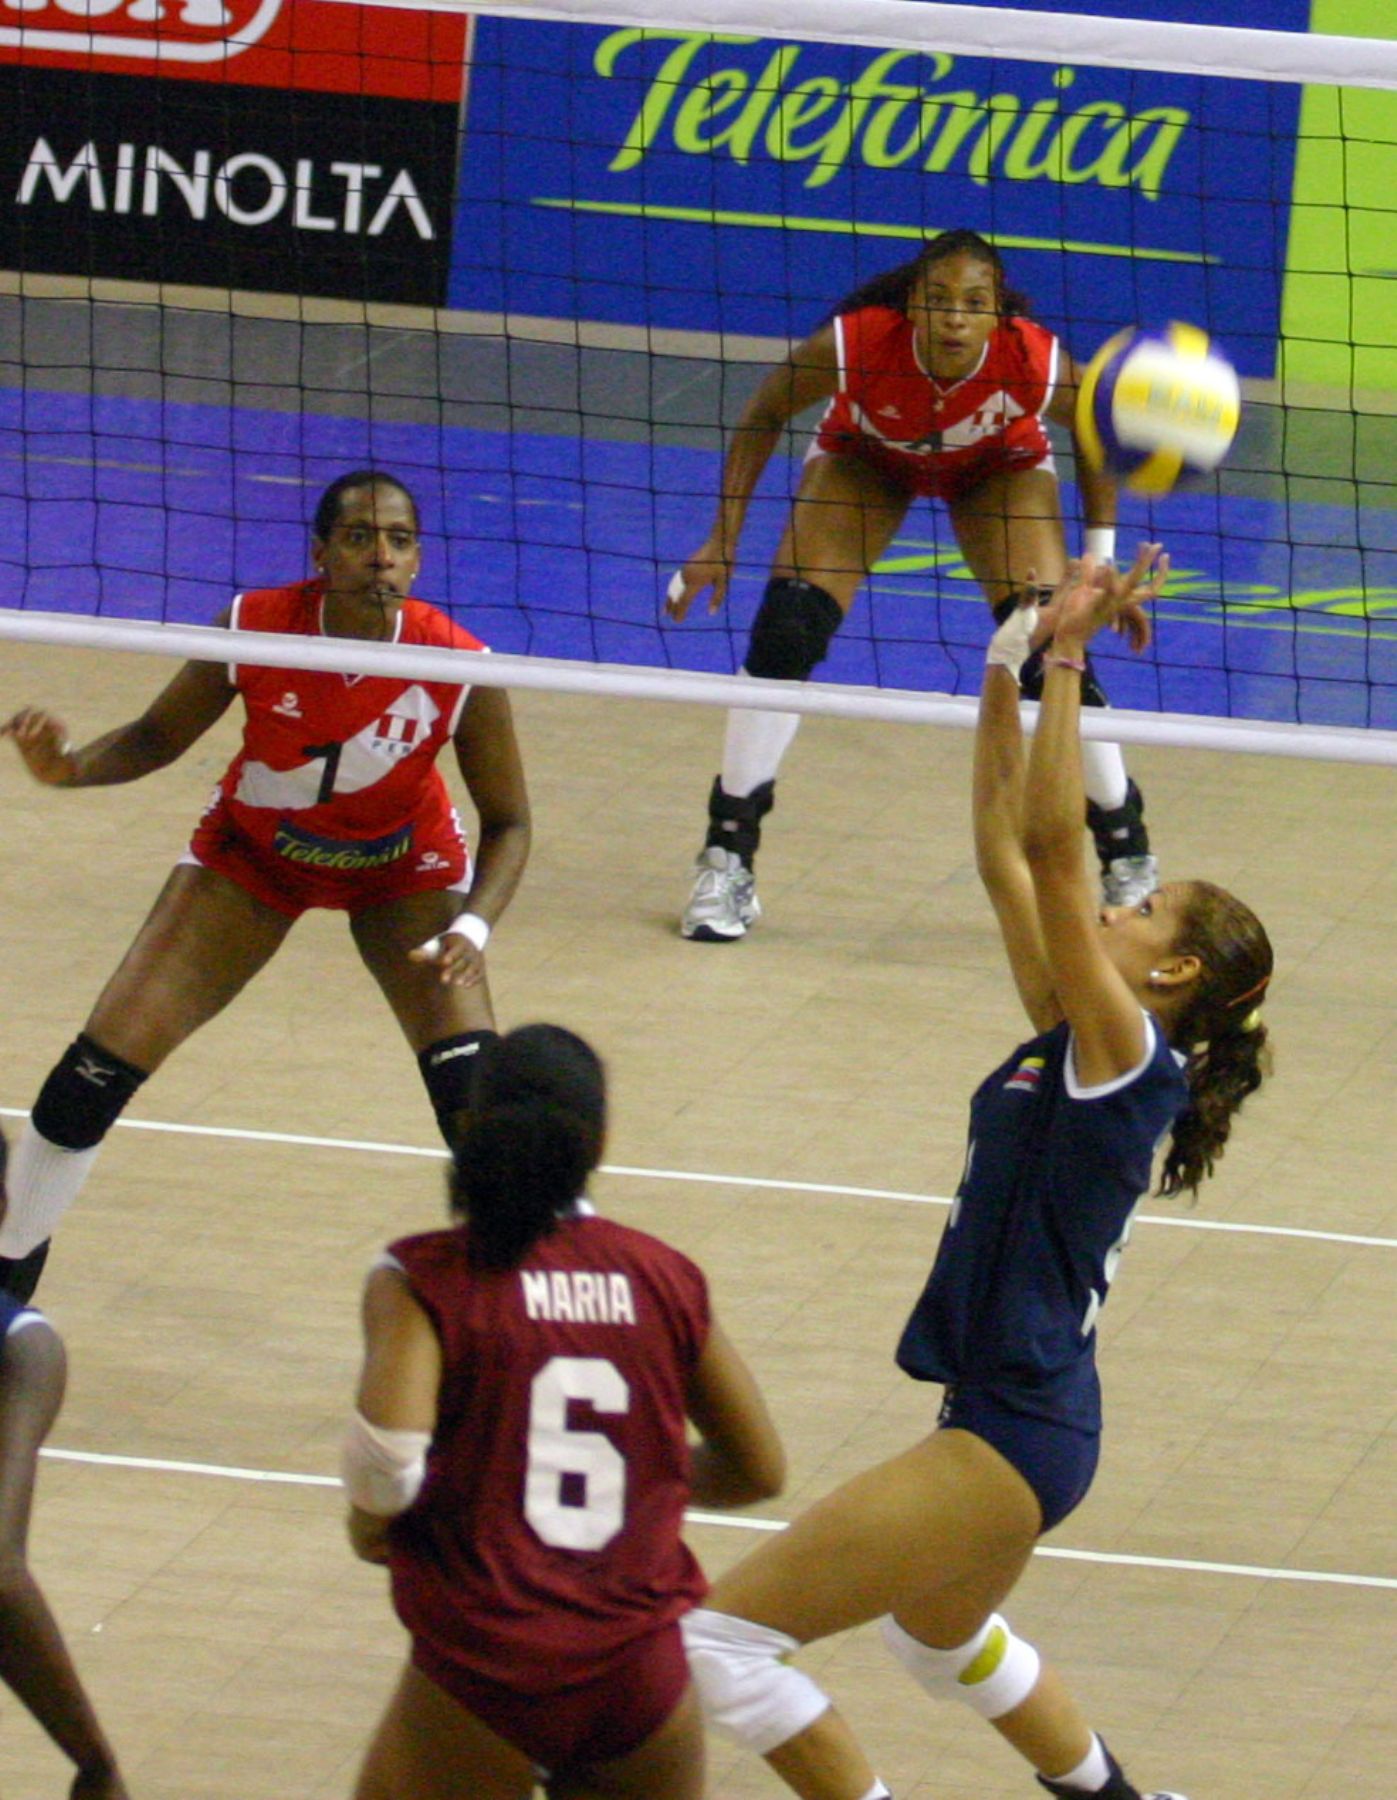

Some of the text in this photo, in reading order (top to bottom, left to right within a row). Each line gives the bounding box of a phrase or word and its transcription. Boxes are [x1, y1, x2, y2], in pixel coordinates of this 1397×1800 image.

[15, 136, 436, 241] MINOLTA
[519, 1269, 637, 1326] MARIA
[523, 1355, 630, 1552] 6
